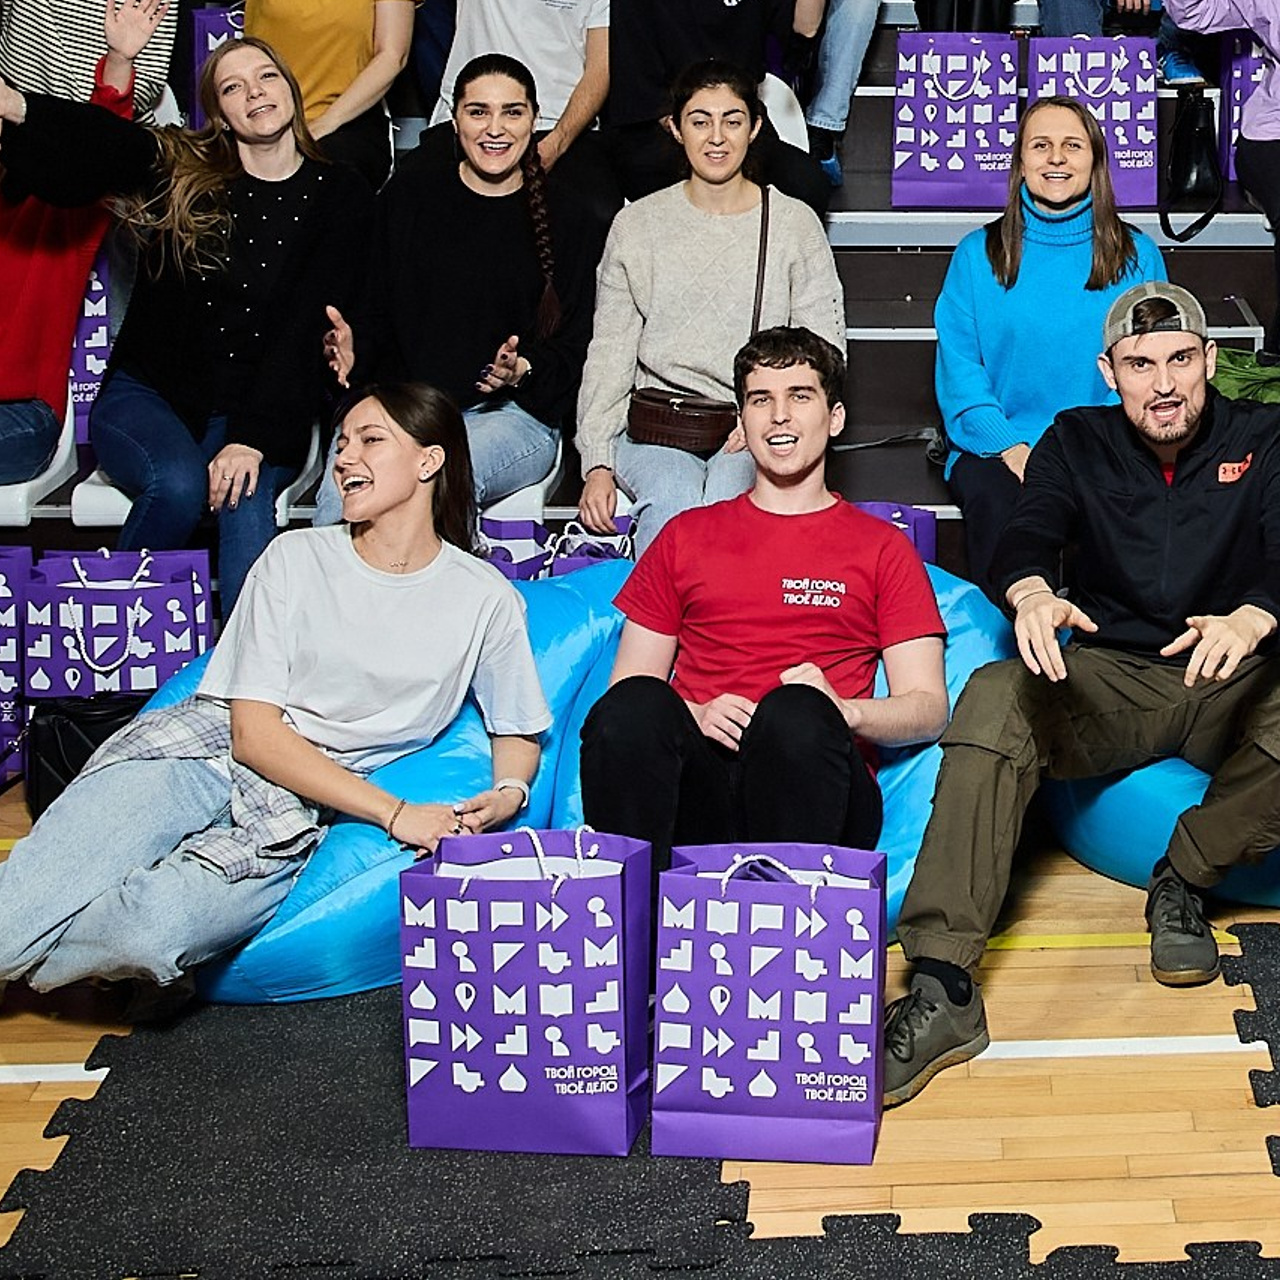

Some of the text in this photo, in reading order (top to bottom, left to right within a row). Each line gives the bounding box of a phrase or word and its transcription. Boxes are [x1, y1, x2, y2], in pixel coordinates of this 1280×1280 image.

[782, 578, 846, 595] ТВОЙ ГОРОД
[783, 592, 841, 608] ТВОЁ ДЕЛО
[544, 1064, 619, 1079] ТВОЙ ГОРОД
[554, 1080, 619, 1095] ТВОЁ ДЕЛО
[795, 1071, 868, 1089] ТВОЙ ГОРОД
[804, 1087, 868, 1103] ТВОЁ ДЕЛО
